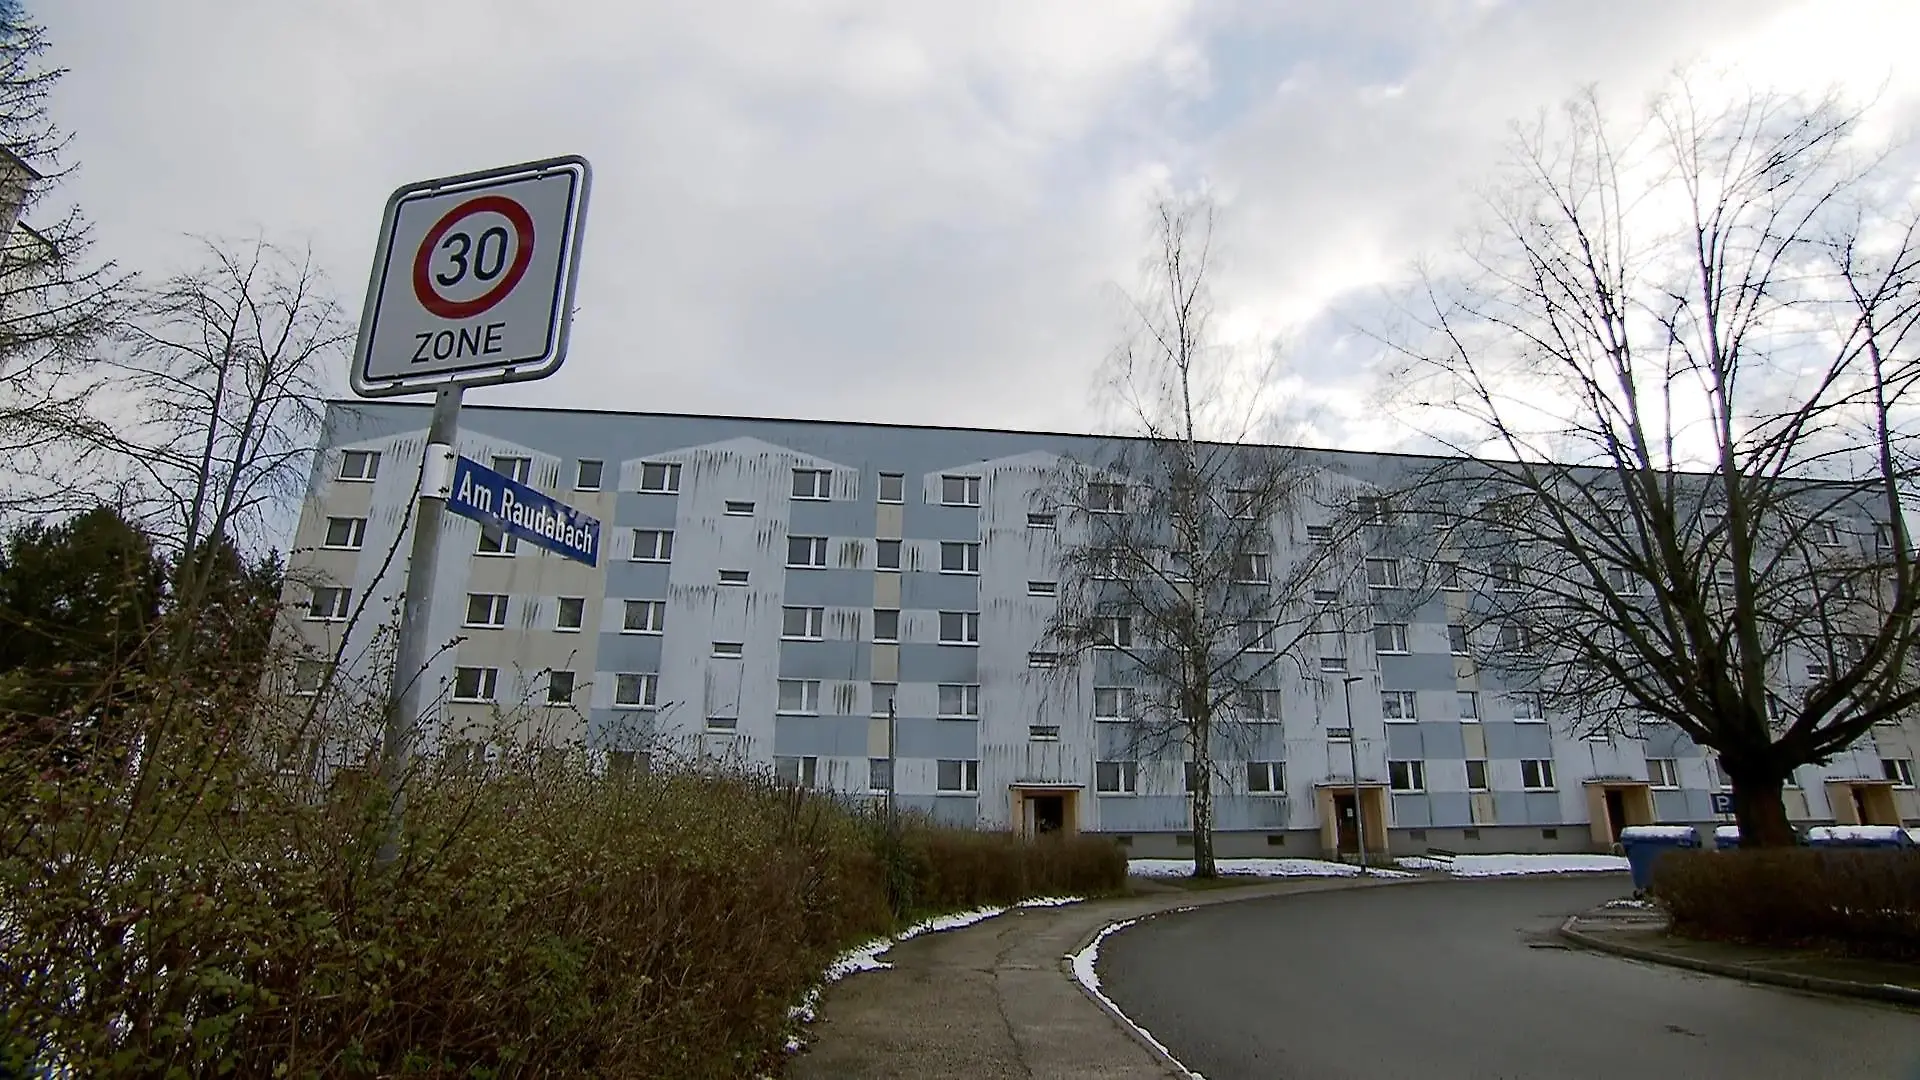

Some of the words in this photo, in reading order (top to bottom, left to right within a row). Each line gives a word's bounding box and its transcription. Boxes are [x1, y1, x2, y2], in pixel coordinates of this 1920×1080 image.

[436, 227, 507, 286] 30
[411, 322, 505, 363] ZONE
[457, 470, 492, 513] Am
[500, 488, 593, 554] Raudabach
[1716, 795, 1730, 811] P
